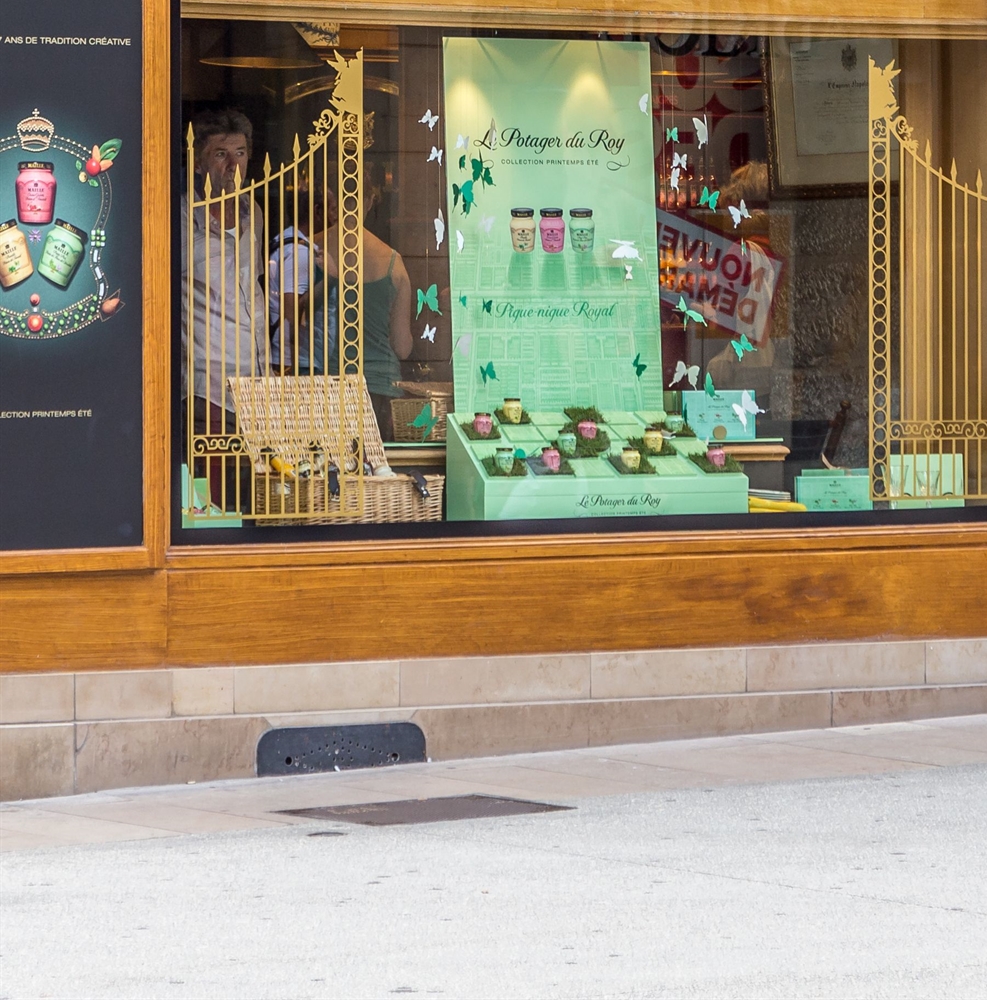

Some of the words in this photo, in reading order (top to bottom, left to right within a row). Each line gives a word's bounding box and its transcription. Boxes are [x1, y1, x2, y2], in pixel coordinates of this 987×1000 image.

[40, 37, 87, 45] TRADITION
[88, 36, 132, 46] CRÉATIVE
[499, 128, 562, 154] Potager
[565, 131, 586, 149] du
[588, 128, 626, 156] Roy
[572, 301, 618, 318] Royal
[78, 408, 92, 417] ÉTÉ
[576, 494, 590, 508] Le
[590, 494, 626, 510] Potager
[627, 495, 638, 506] du
[640, 493, 662, 508] Roy
